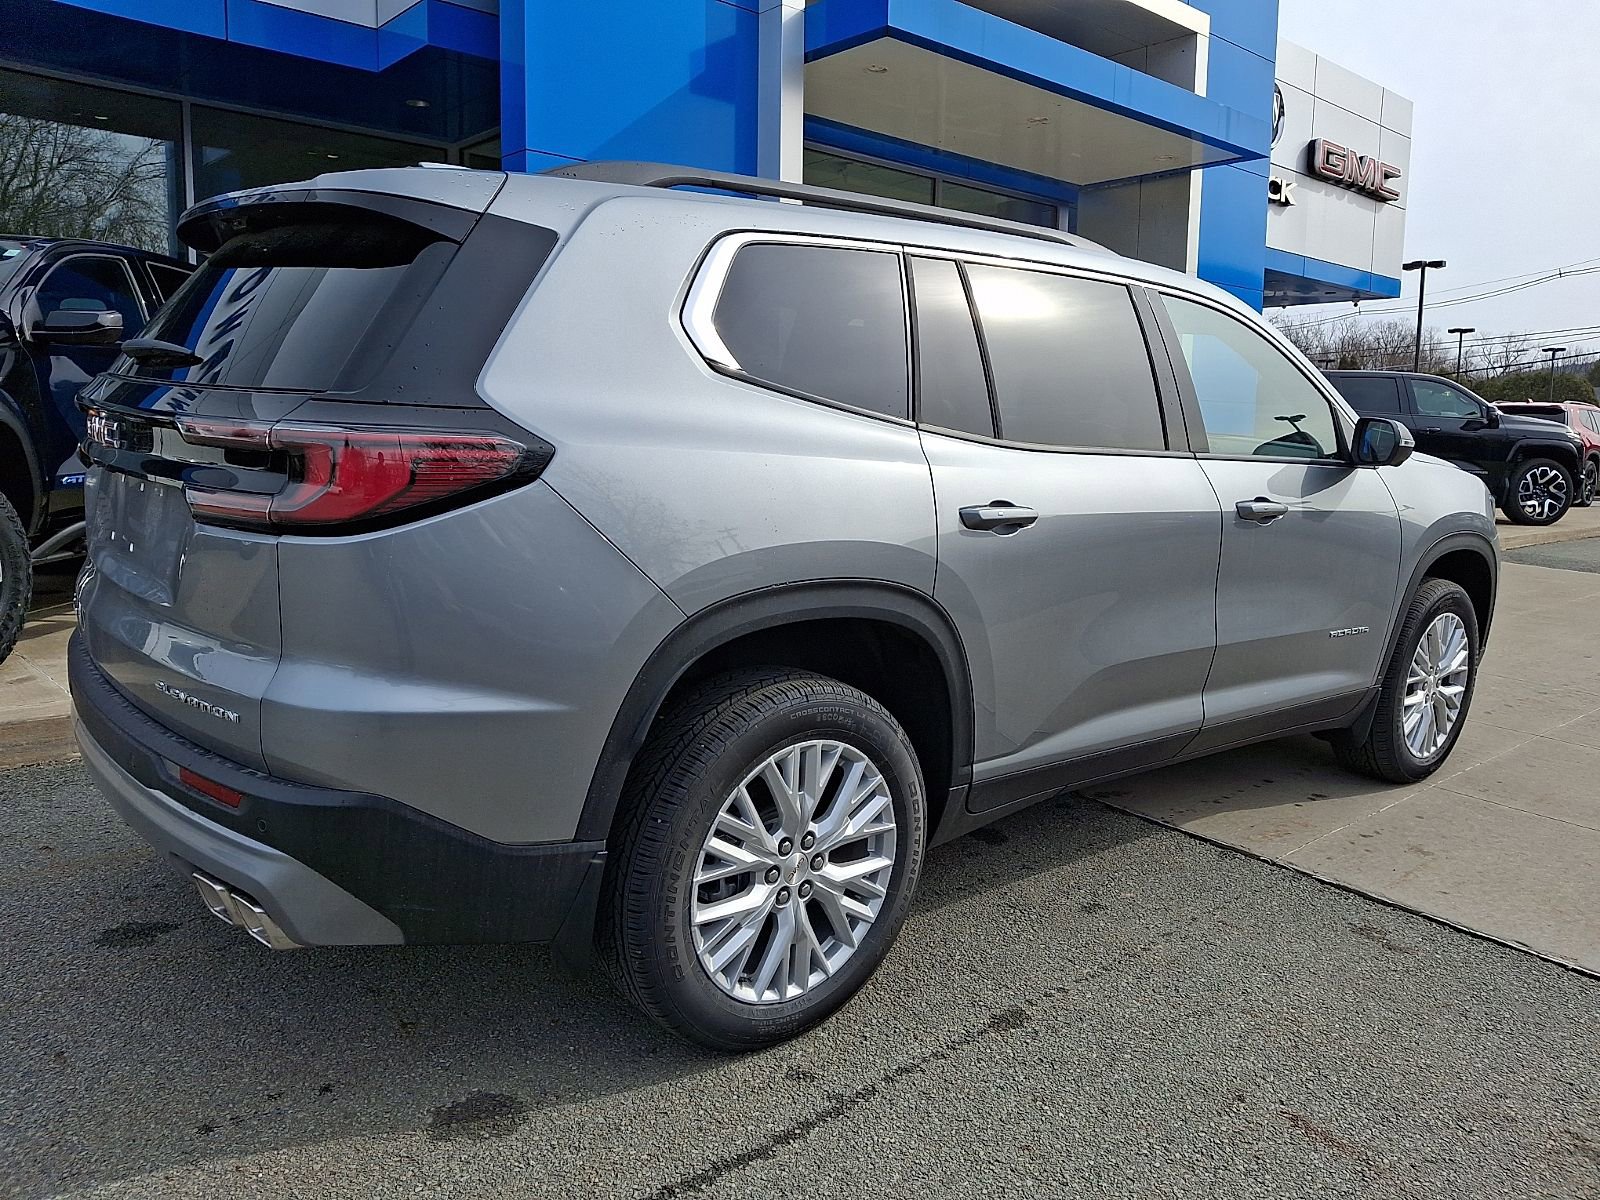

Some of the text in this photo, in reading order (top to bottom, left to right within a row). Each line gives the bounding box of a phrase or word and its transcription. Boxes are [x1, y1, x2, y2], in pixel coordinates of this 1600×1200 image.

[1313, 138, 1402, 201] GMC
[1329, 626, 1369, 638] ACADIA
[154, 680, 240, 724] ELEVATION
[790, 705, 854, 719] CROSSCONTACT
